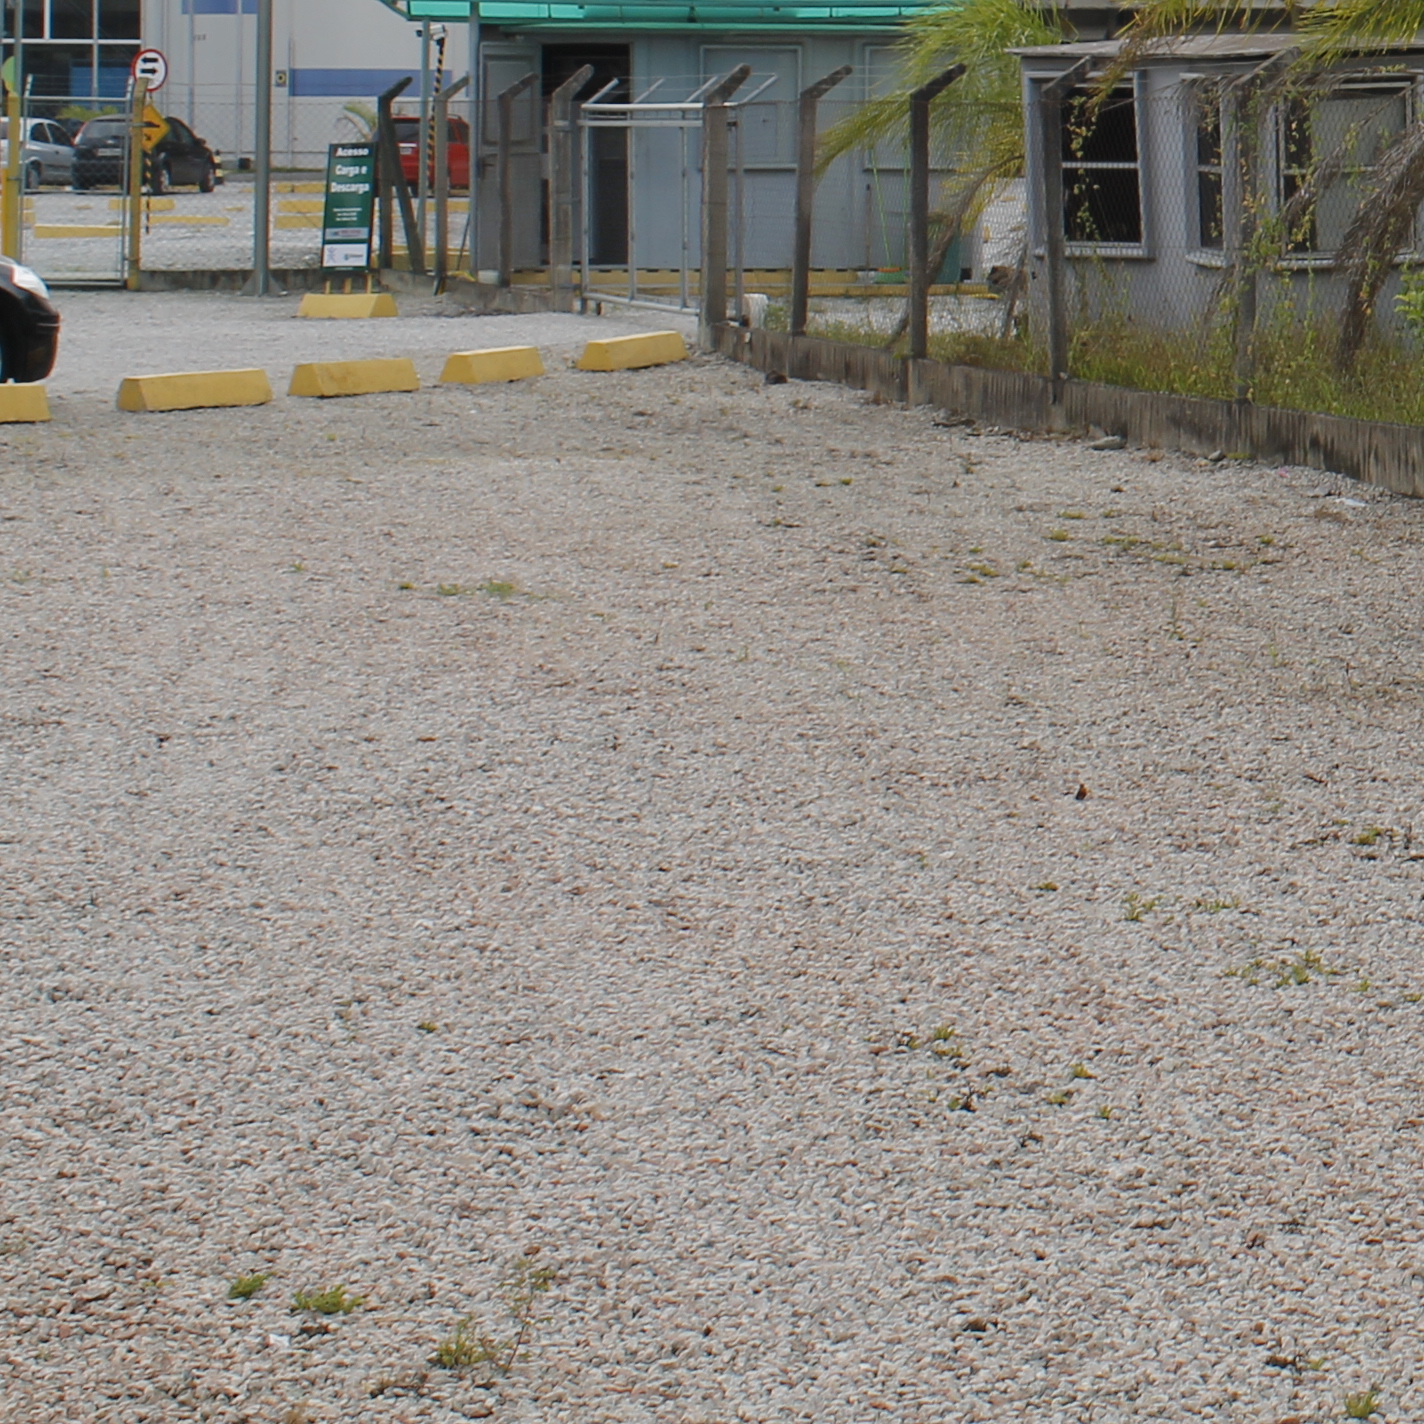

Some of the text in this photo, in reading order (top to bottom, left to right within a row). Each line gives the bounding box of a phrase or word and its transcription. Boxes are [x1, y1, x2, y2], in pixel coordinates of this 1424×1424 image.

[335, 147, 369, 157] Acesso
[335, 164, 368, 177] Carga e
[331, 182, 370, 194] Descarga
